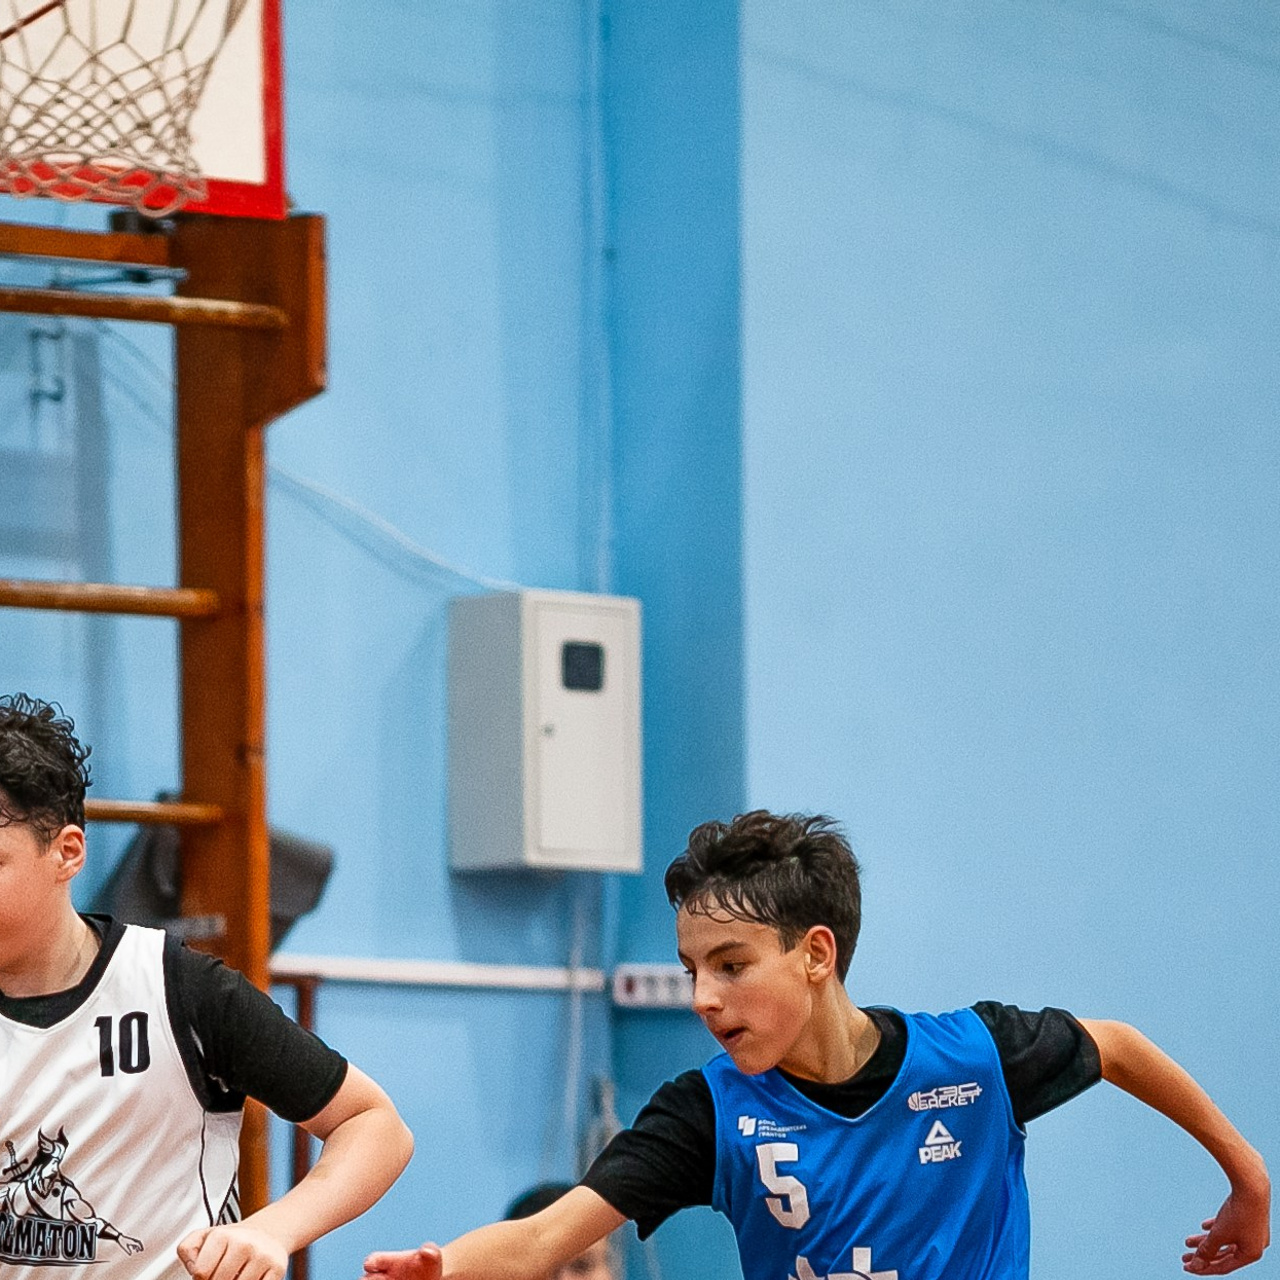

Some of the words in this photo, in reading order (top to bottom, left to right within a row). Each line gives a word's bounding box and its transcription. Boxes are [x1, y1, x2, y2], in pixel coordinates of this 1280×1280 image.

[93, 1011, 151, 1077] 10
[918, 1140, 963, 1165] PEAK
[755, 1142, 811, 1230] 5
